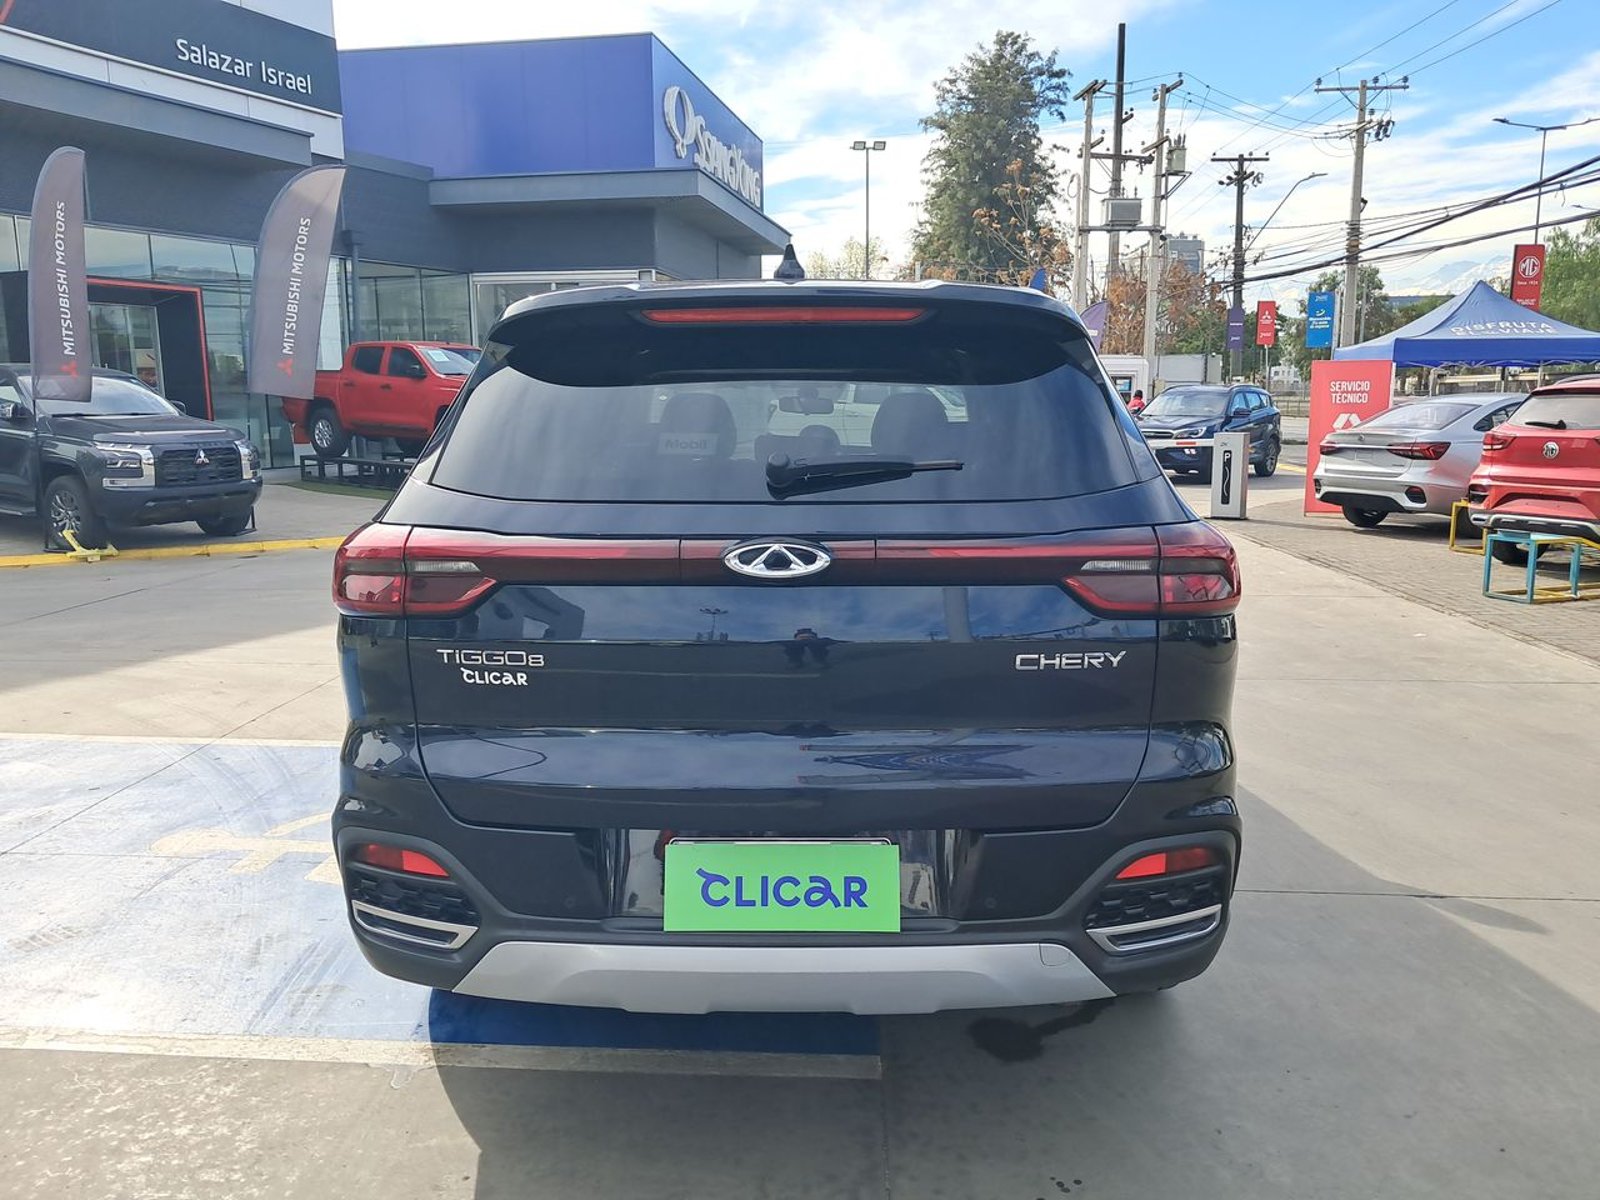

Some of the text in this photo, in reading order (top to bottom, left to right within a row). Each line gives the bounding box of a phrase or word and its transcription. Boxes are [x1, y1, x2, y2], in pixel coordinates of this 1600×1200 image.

[176, 38, 312, 95] Salazar Israel
[1520, 257, 1539, 277] MG
[54, 200, 76, 356] MITSUBISHI MOTORS
[282, 217, 311, 355] MITSUBISHI MOTORS
[1450, 321, 1552, 333] DISFRUTA
[1330, 380, 1370, 391] SERVICIO
[1224, 452, 1231, 462] P
[1015, 651, 1127, 670] CHERY
